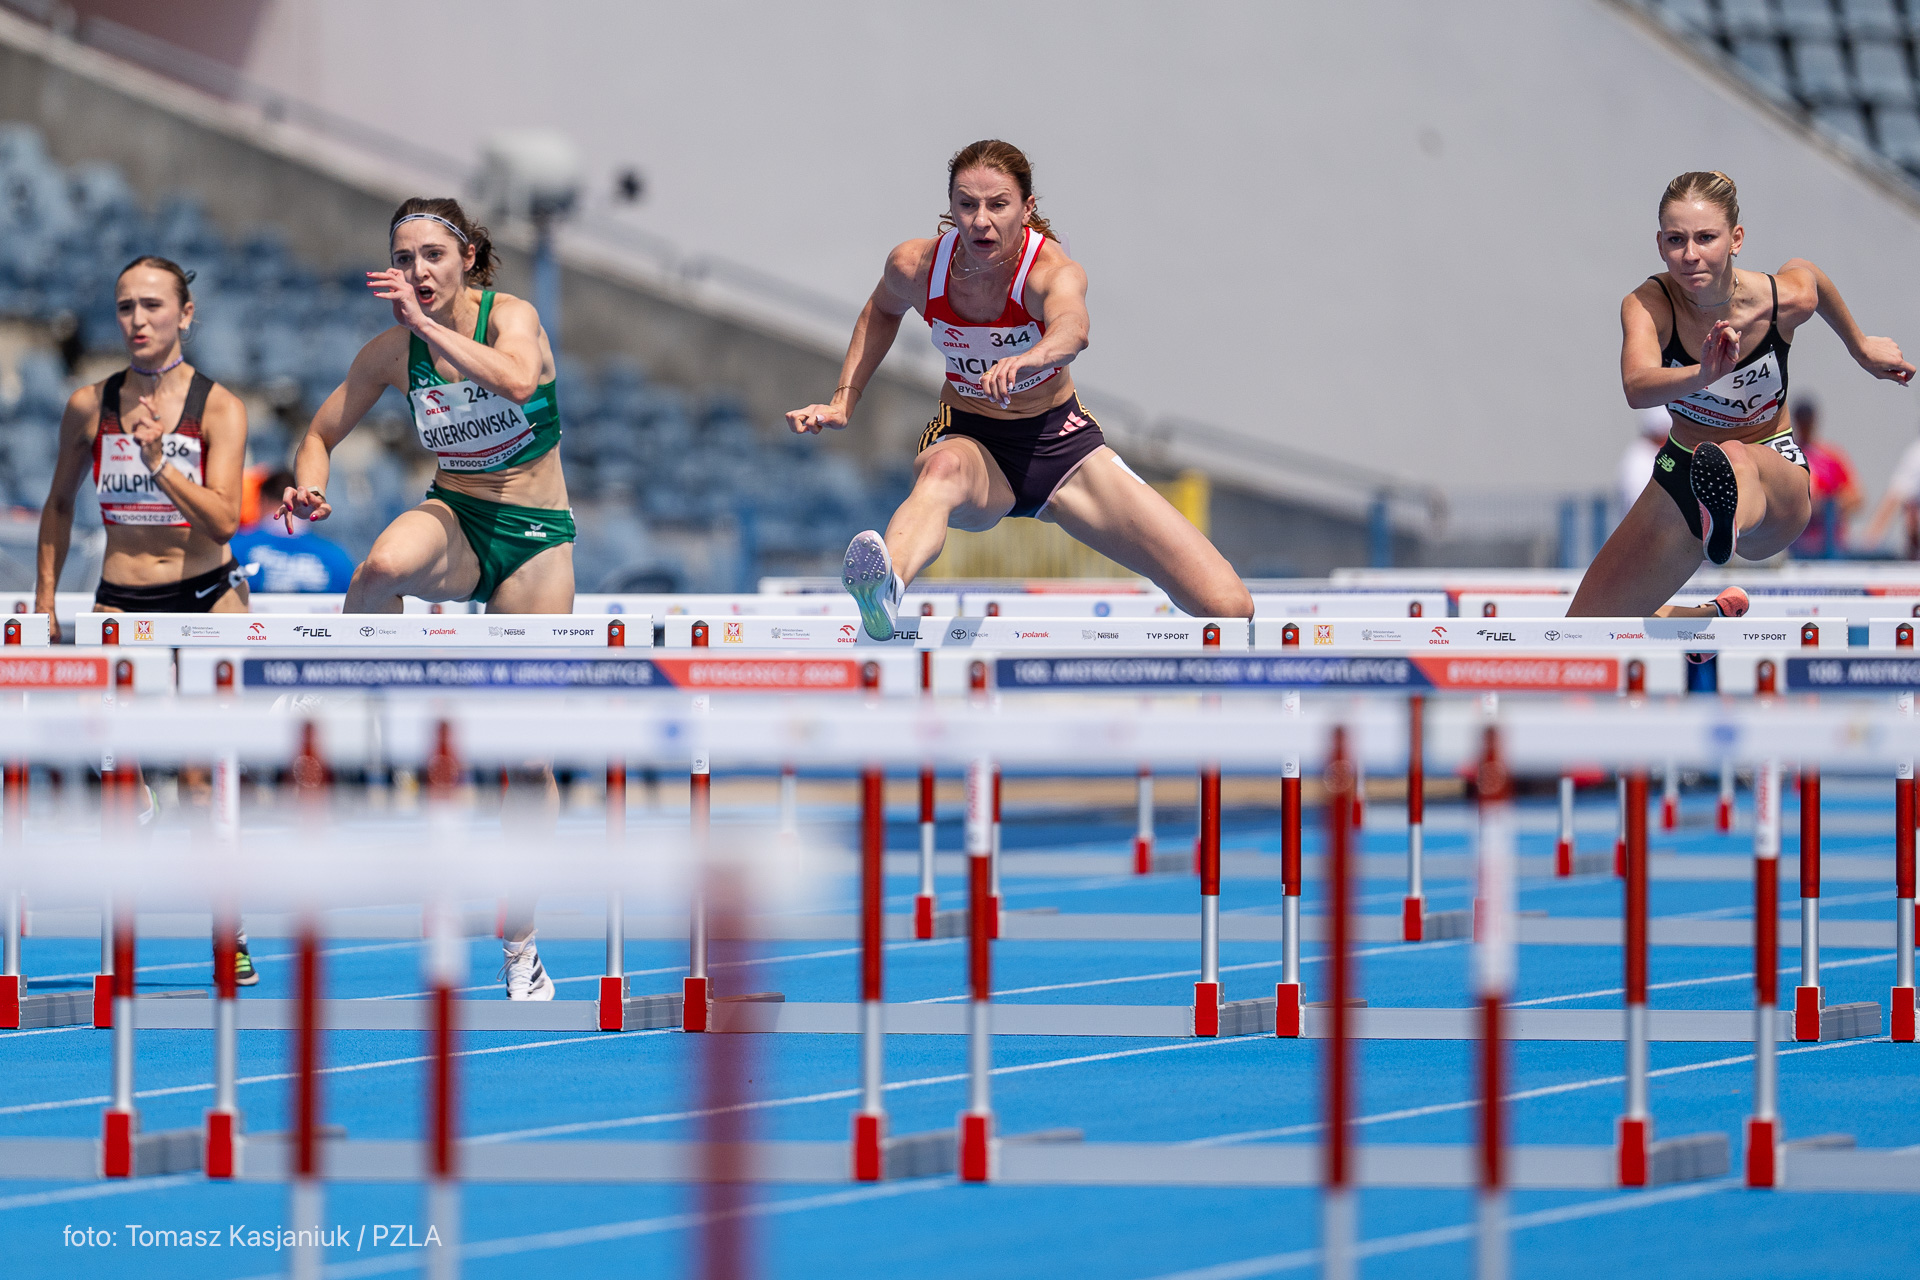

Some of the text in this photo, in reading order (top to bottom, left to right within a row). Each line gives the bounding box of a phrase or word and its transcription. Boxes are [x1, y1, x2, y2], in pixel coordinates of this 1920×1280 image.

[990, 330, 1031, 348] 344
[943, 341, 970, 349] ORLEN
[1732, 362, 1771, 389] 524
[1017, 376, 1042, 390] 2024
[425, 405, 451, 416] ORLEN
[1681, 407, 1741, 428] BYDGOSZCZ
[424, 408, 522, 449] SKIERKOWSKA
[161, 441, 190, 457] 36
[450, 443, 523, 467] BYDGOSZCZ 2024
[302, 629, 332, 637] FUEL
[429, 628, 457, 636] polanik
[893, 631, 923, 640] FUEL
[1486, 632, 1516, 641] FUEL
[1616, 632, 1644, 640] polanik
[1761, 633, 1787, 641] SPORT
